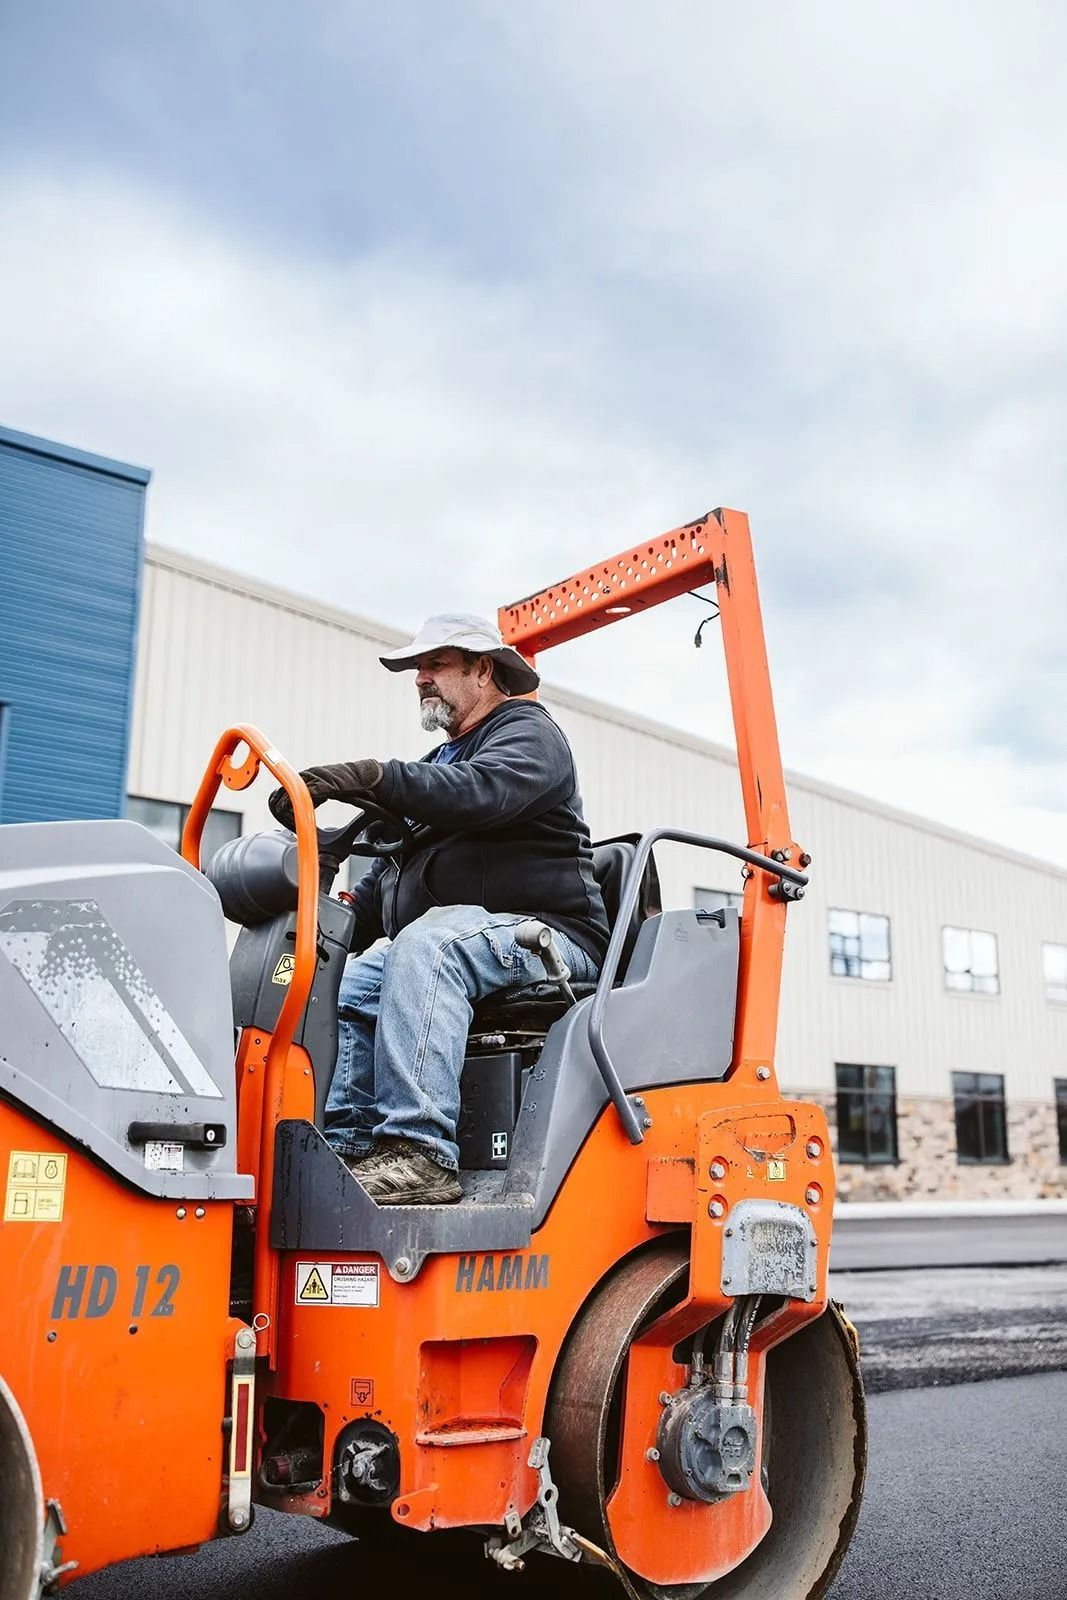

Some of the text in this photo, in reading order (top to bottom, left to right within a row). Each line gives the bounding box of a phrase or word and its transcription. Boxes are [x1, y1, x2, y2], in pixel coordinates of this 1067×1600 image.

[343, 1265, 376, 1274] DANGER
[455, 1254, 549, 1293] HAMM
[50, 1264, 181, 1320] HD 12
